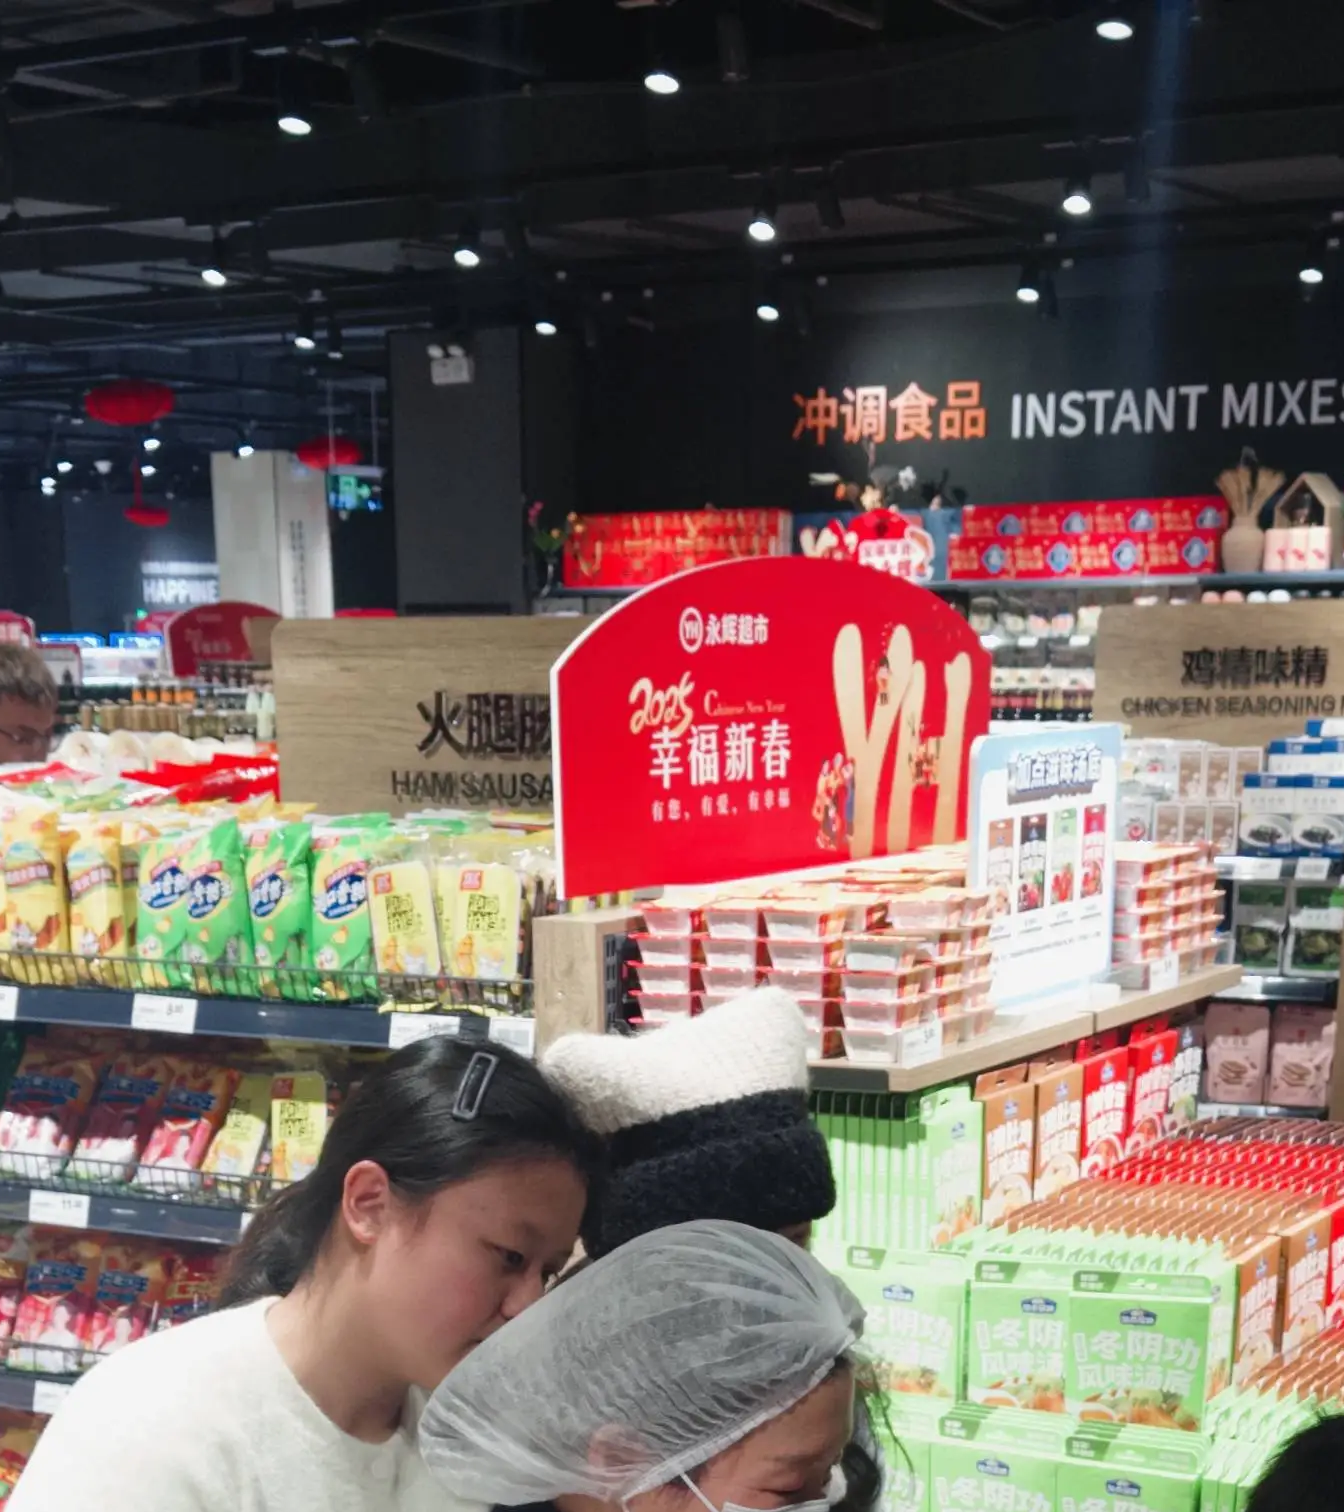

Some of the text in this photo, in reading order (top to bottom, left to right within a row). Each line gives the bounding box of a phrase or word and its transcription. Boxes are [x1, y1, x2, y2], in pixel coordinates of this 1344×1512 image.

[792, 381, 986, 445] 冲调食品
[1010, 385, 1208, 439] INSTANT
[705, 613, 769, 646] 永辉超市
[1181, 646, 1330, 690] 鸡精味精
[628, 672, 695, 737] 2025
[1121, 695, 1209, 717] CHICKEN
[1214, 694, 1335, 716] SEASONING
[649, 720, 791, 789] 幸福新春
[392, 771, 455, 798] HAM
[1091, 1331, 1200, 1372] 冬阴功
[1077, 1364, 1193, 1396] 风味汤底
